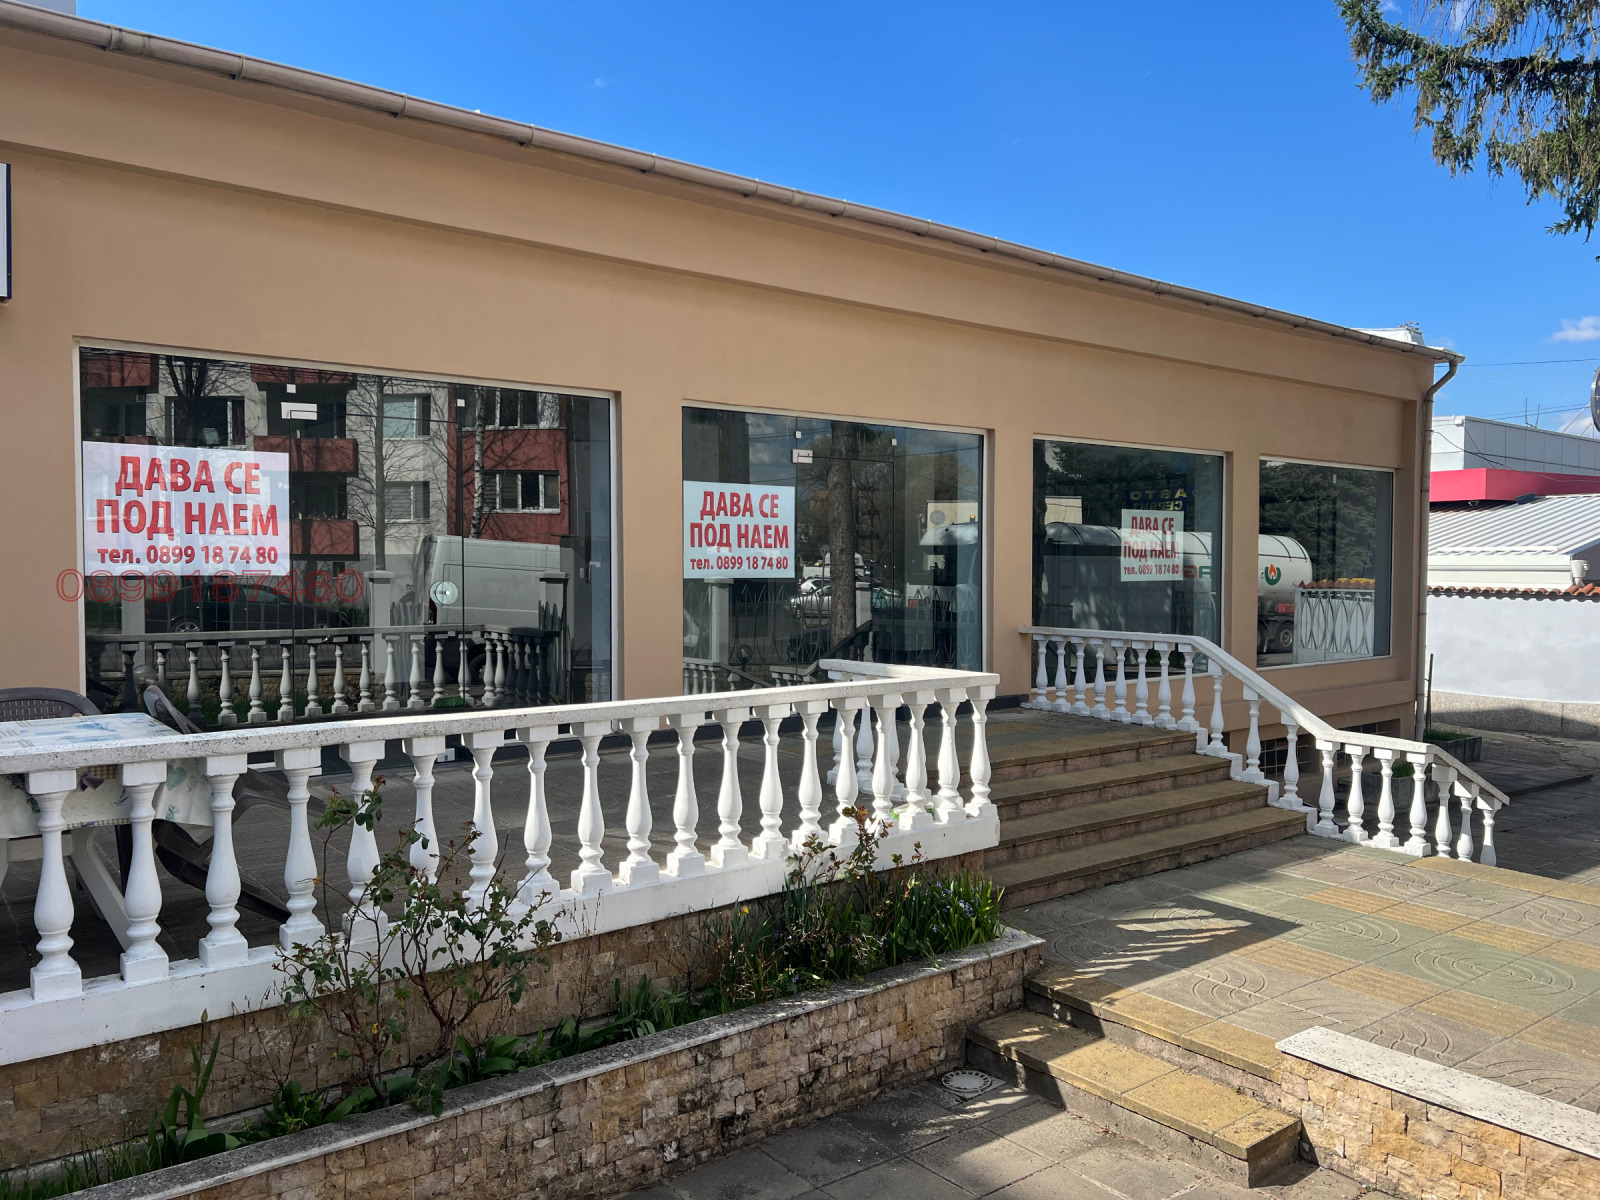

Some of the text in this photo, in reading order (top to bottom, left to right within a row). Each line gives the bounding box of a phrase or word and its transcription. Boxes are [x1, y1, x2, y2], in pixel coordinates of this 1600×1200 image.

[115, 455, 261, 497] ДАВА СЕ
[700, 490, 779, 521] ДАВА СЕ
[95, 498, 279, 541] ПОД НАЕМ
[1129, 516, 1175, 538] ДАВА СЕ
[690, 522, 789, 553] ПОД НАЕМ
[97, 544, 278, 565] тел. 0899 18 74 80
[1123, 540, 1180, 562] ПОД НАЕМ
[690, 555, 788, 570] тел. 0899 18 74 80
[1123, 564, 1180, 575] тел. 0899 18 74 80
